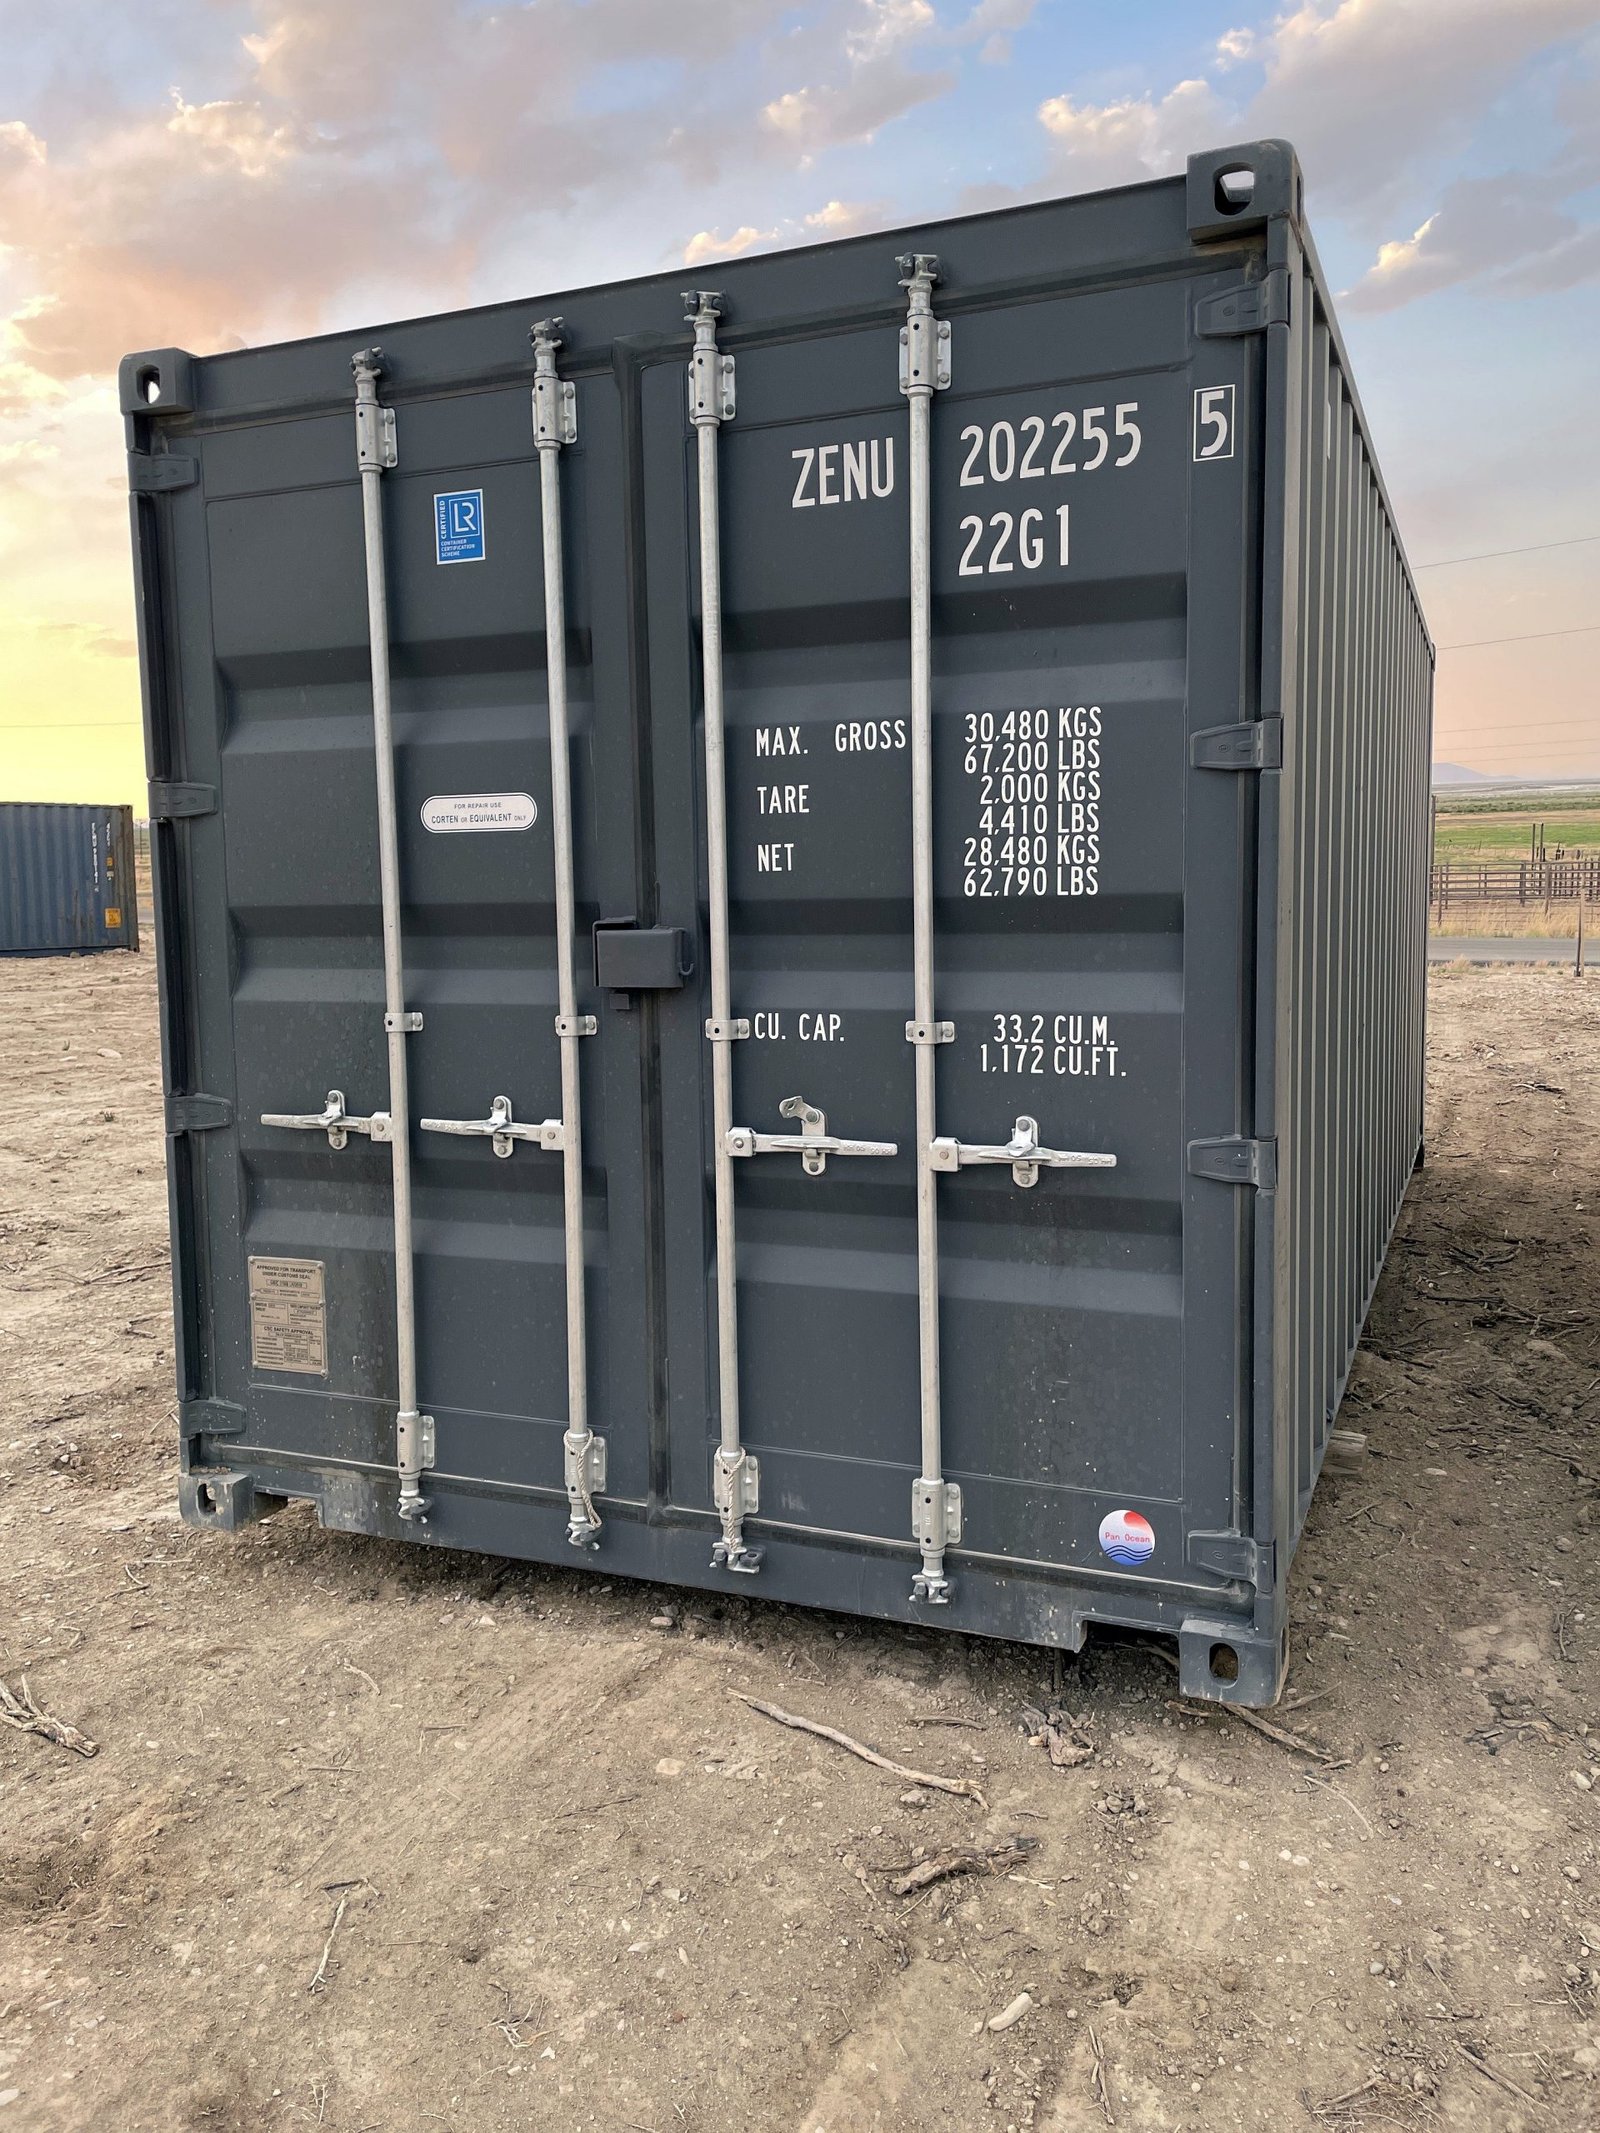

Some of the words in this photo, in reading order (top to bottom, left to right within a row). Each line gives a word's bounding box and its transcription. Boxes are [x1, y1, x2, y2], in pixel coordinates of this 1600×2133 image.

[791, 436, 894, 508] ZENU
[959, 401, 1141, 487] 202255
[1199, 389, 1228, 457] 5
[439, 500, 447, 539] CERTIFIED
[453, 502, 477, 533] LR
[441, 538, 467, 546] CONTAINER
[958, 504, 1069, 577] 22G1
[756, 726, 809, 757] MAX.
[834, 719, 906, 752] GROSS
[964, 709, 1049, 743] 30,480
[1058, 706, 1102, 738] KGS
[964, 740, 1049, 774] 67,200
[1058, 738, 1101, 770] LBS
[756, 784, 810, 815] TARE
[980, 772, 1048, 805] 2,000
[1057, 770, 1101, 802] KGS
[431, 815, 459, 824] CORTEN
[469, 813, 512, 823] EQUIVALENT
[979, 804, 1048, 836] 4,410
[1057, 802, 1100, 834] LBS
[757, 843, 795, 872] NET
[963, 835, 1048, 867] 28,480
[1057, 834, 1100, 865] KGS
[963, 866, 1047, 897] 62,790
[1056, 865, 1099, 896] LBS
[754, 1012, 786, 1040] CU.
[798, 1013, 845, 1042] CAP.
[993, 1013, 1044, 1044] 33.2
[1053, 1014, 1115, 1046] CU.M.
[980, 1043, 1044, 1074] 1,172
[1053, 1045, 1127, 1077] CU.FT.
[290, 1328, 314, 1336] APPROVAL
[1105, 1531, 1120, 1541] Pan
[1124, 1533, 1151, 1543] Ocean
